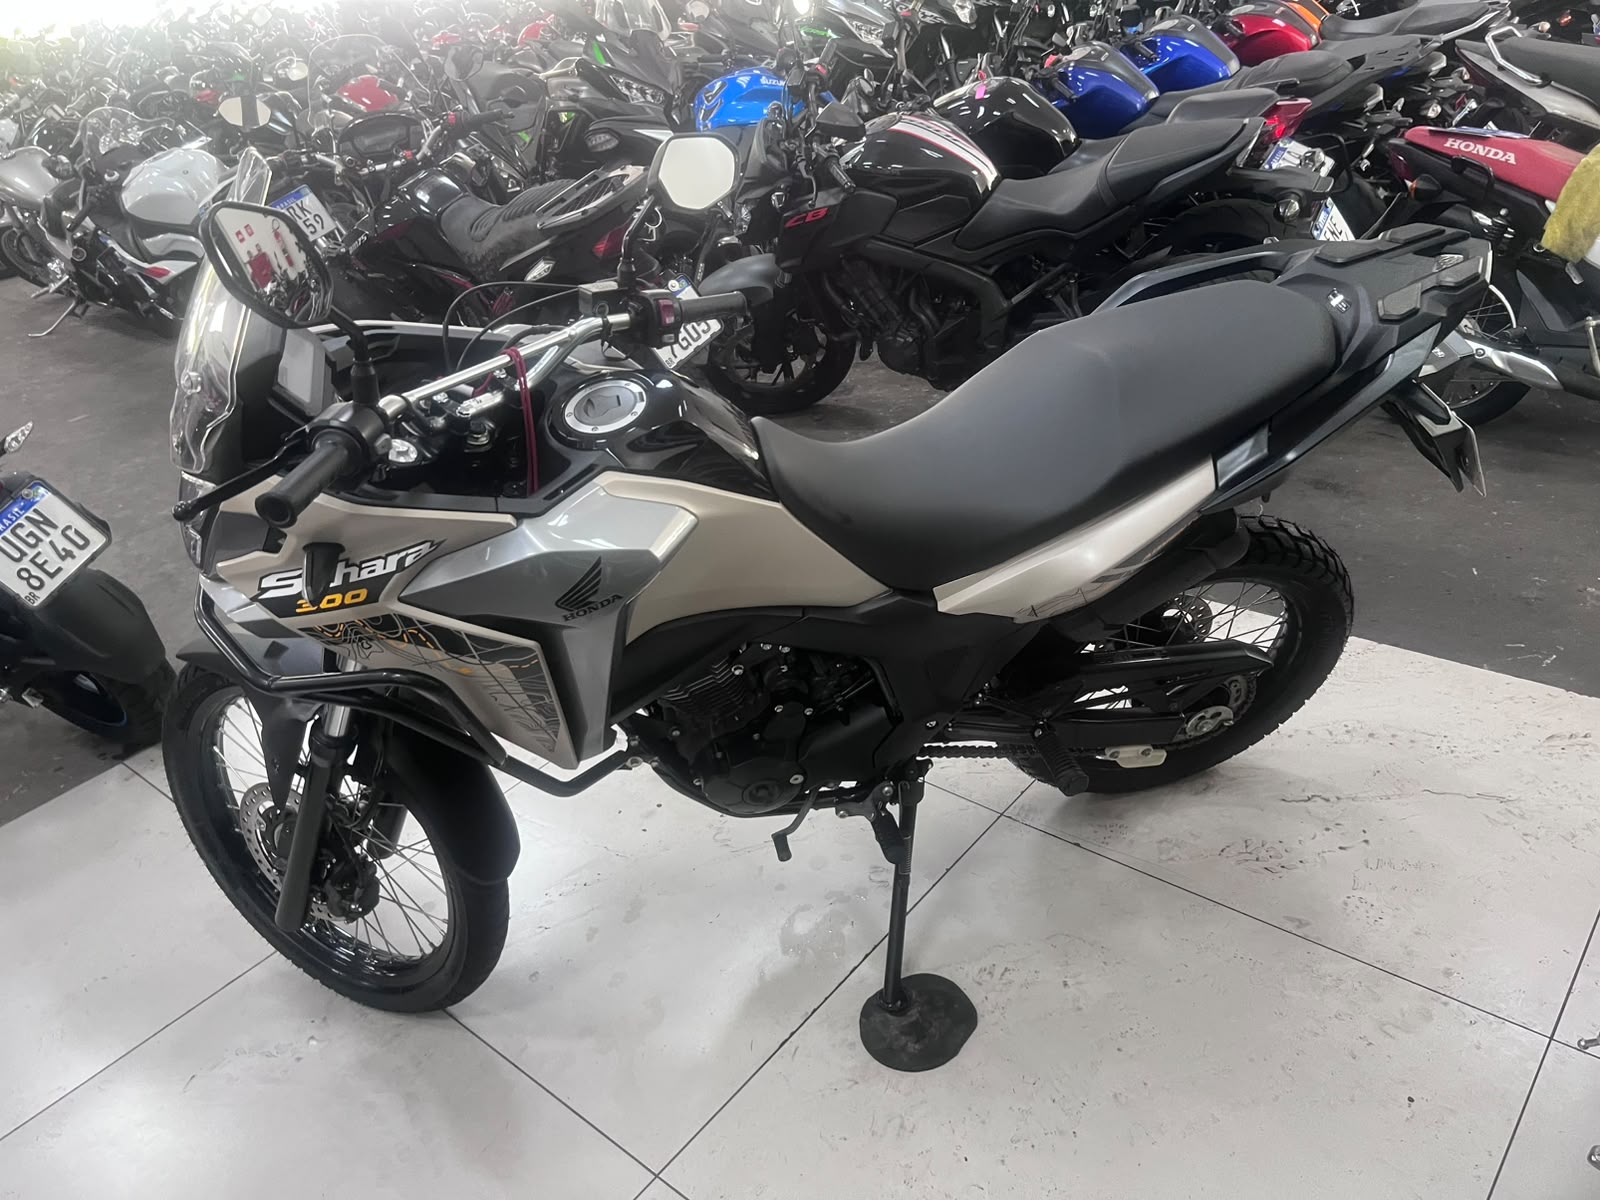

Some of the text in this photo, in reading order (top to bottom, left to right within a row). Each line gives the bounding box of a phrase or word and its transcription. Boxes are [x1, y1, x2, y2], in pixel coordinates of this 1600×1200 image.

[1444, 138, 1517, 165] HONDA
[784, 207, 829, 229] CB
[0, 507, 59, 563] UGN
[16, 524, 91, 591] 8E40
[257, 540, 438, 600] Shara
[24, 591, 41, 606] BR
[562, 594, 624, 622] HONDA
